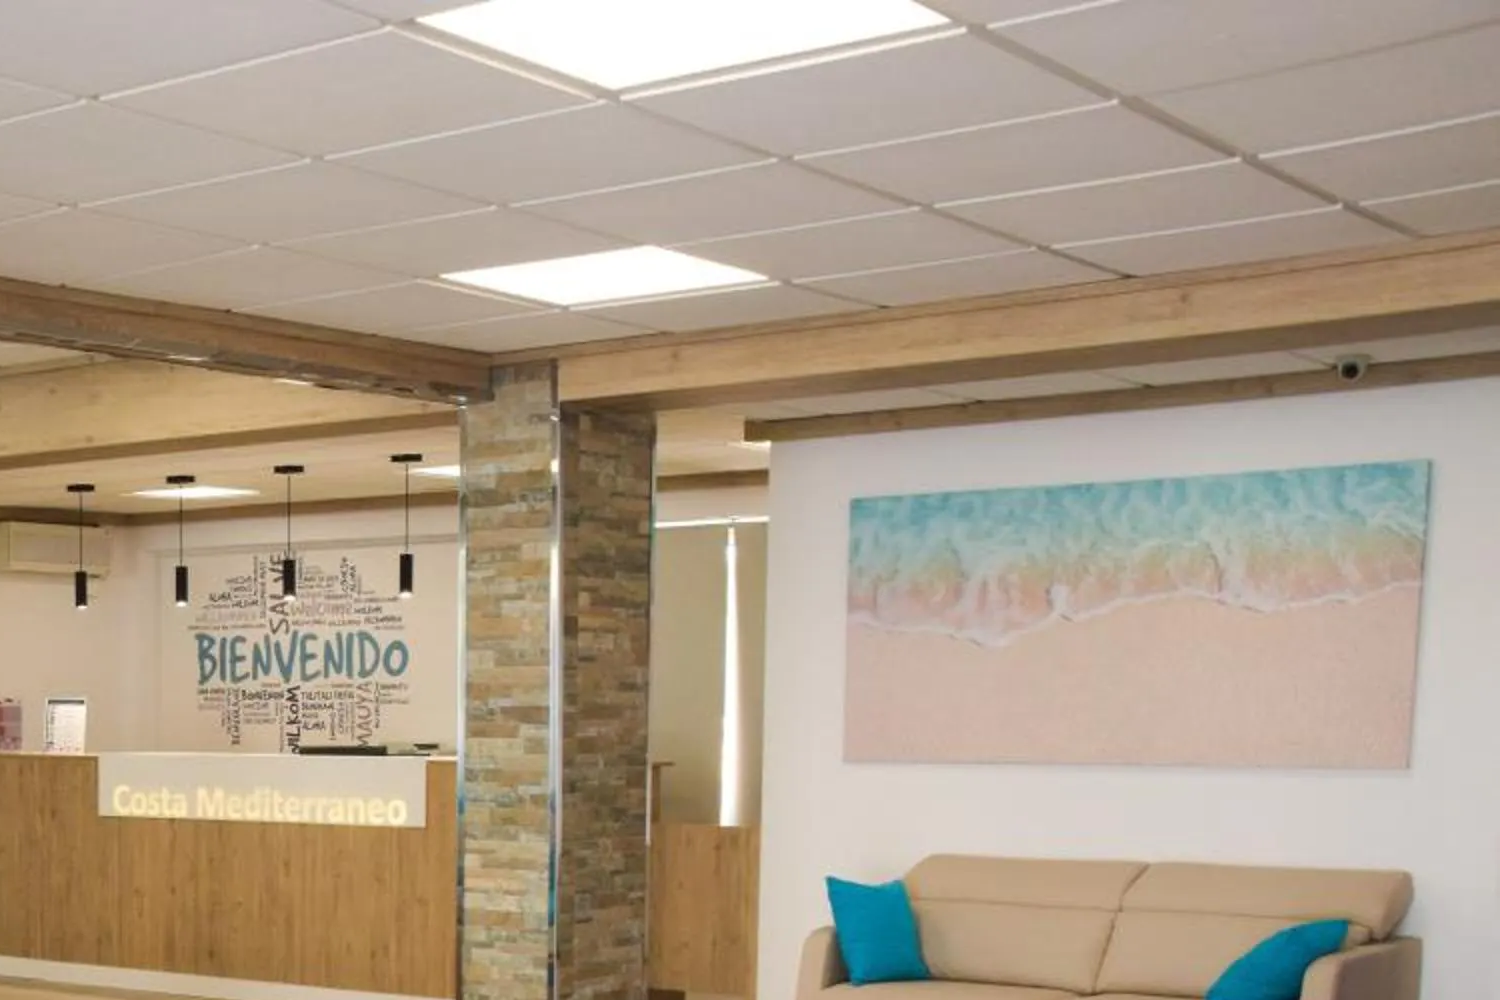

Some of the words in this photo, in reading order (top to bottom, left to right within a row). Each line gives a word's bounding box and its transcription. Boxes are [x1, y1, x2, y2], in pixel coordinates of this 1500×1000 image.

[195, 630, 409, 686] BIENVENIDO
[113, 785, 187, 817] Costa
[197, 786, 407, 825] Mediterraneo
